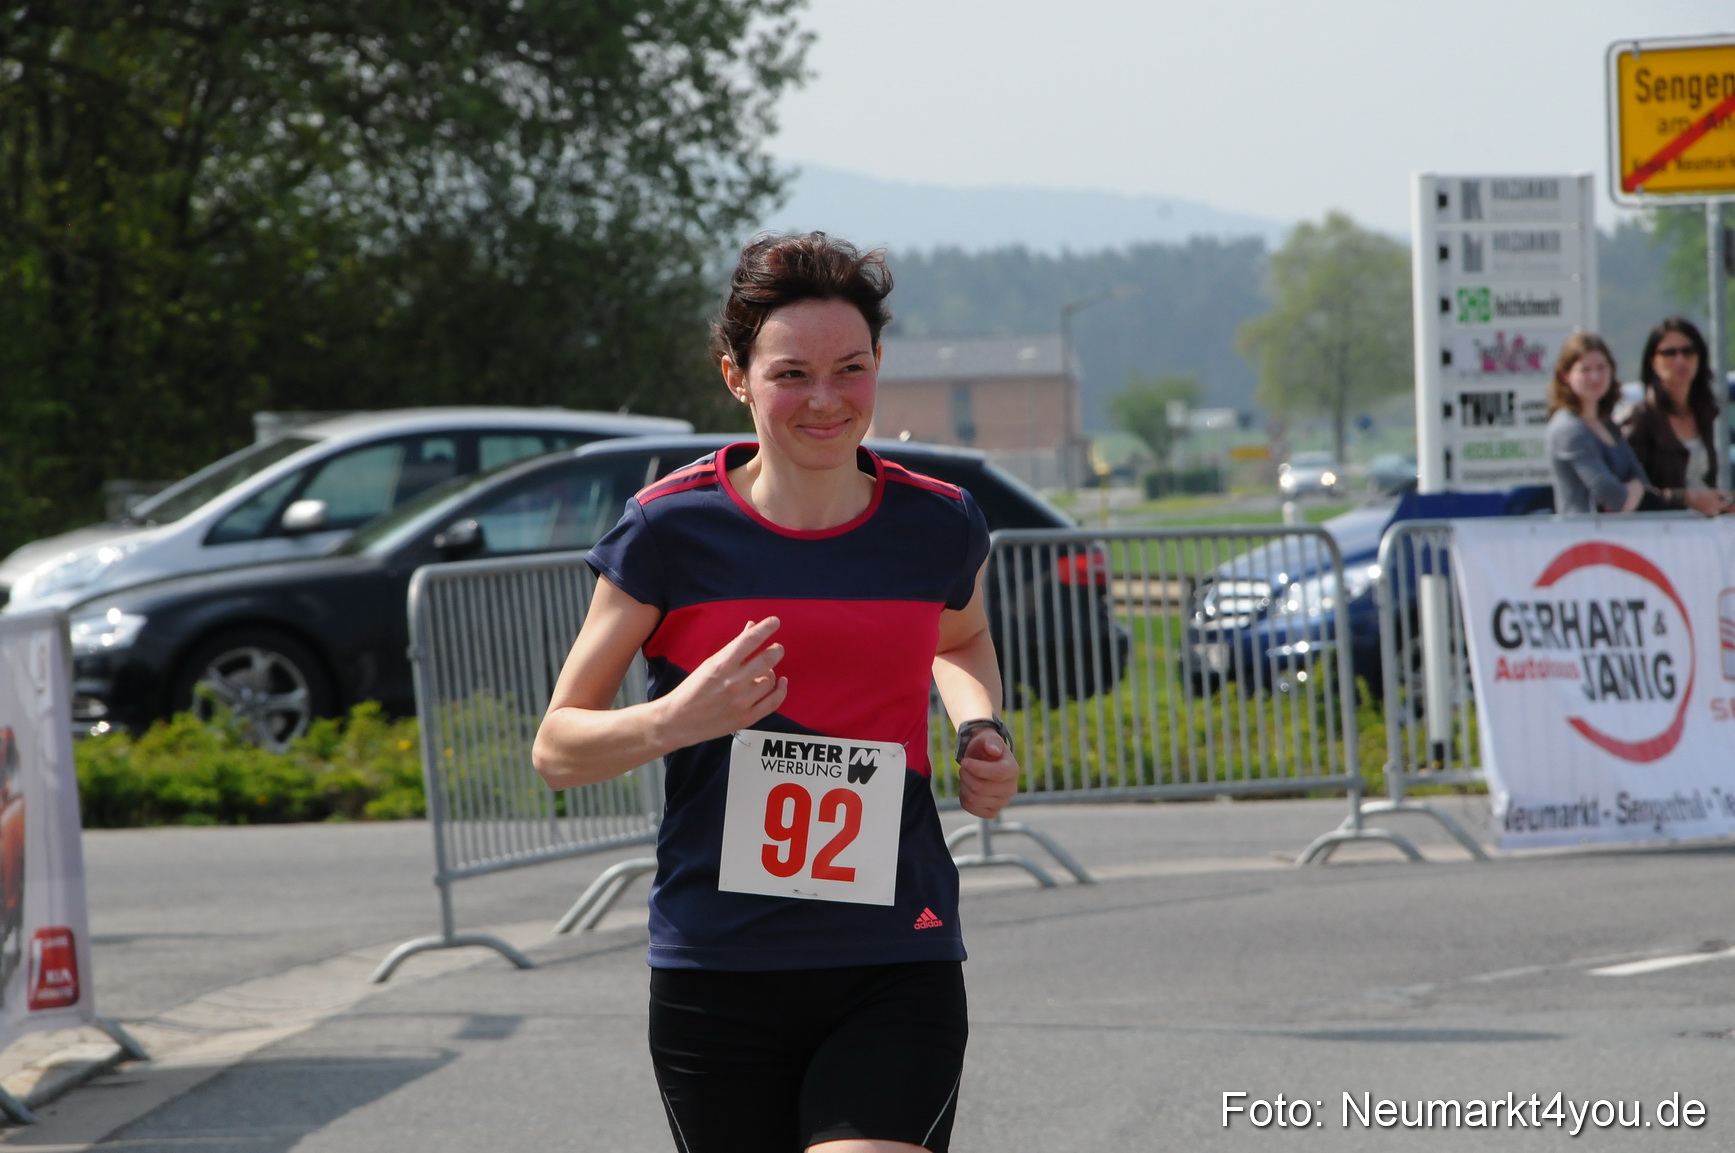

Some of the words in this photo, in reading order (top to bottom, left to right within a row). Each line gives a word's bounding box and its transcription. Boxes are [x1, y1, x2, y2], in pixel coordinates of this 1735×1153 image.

[1636, 68, 1735, 110] Sengen
[1460, 391, 1515, 427] THULE
[1492, 599, 1646, 650] GERHART
[1653, 611, 1667, 636] &
[1581, 652, 1677, 703] JANIG
[761, 738, 843, 764] MEYER
[761, 758, 843, 779] WERBUNG
[761, 782, 863, 882] 92
[914, 919, 943, 930] adidas
